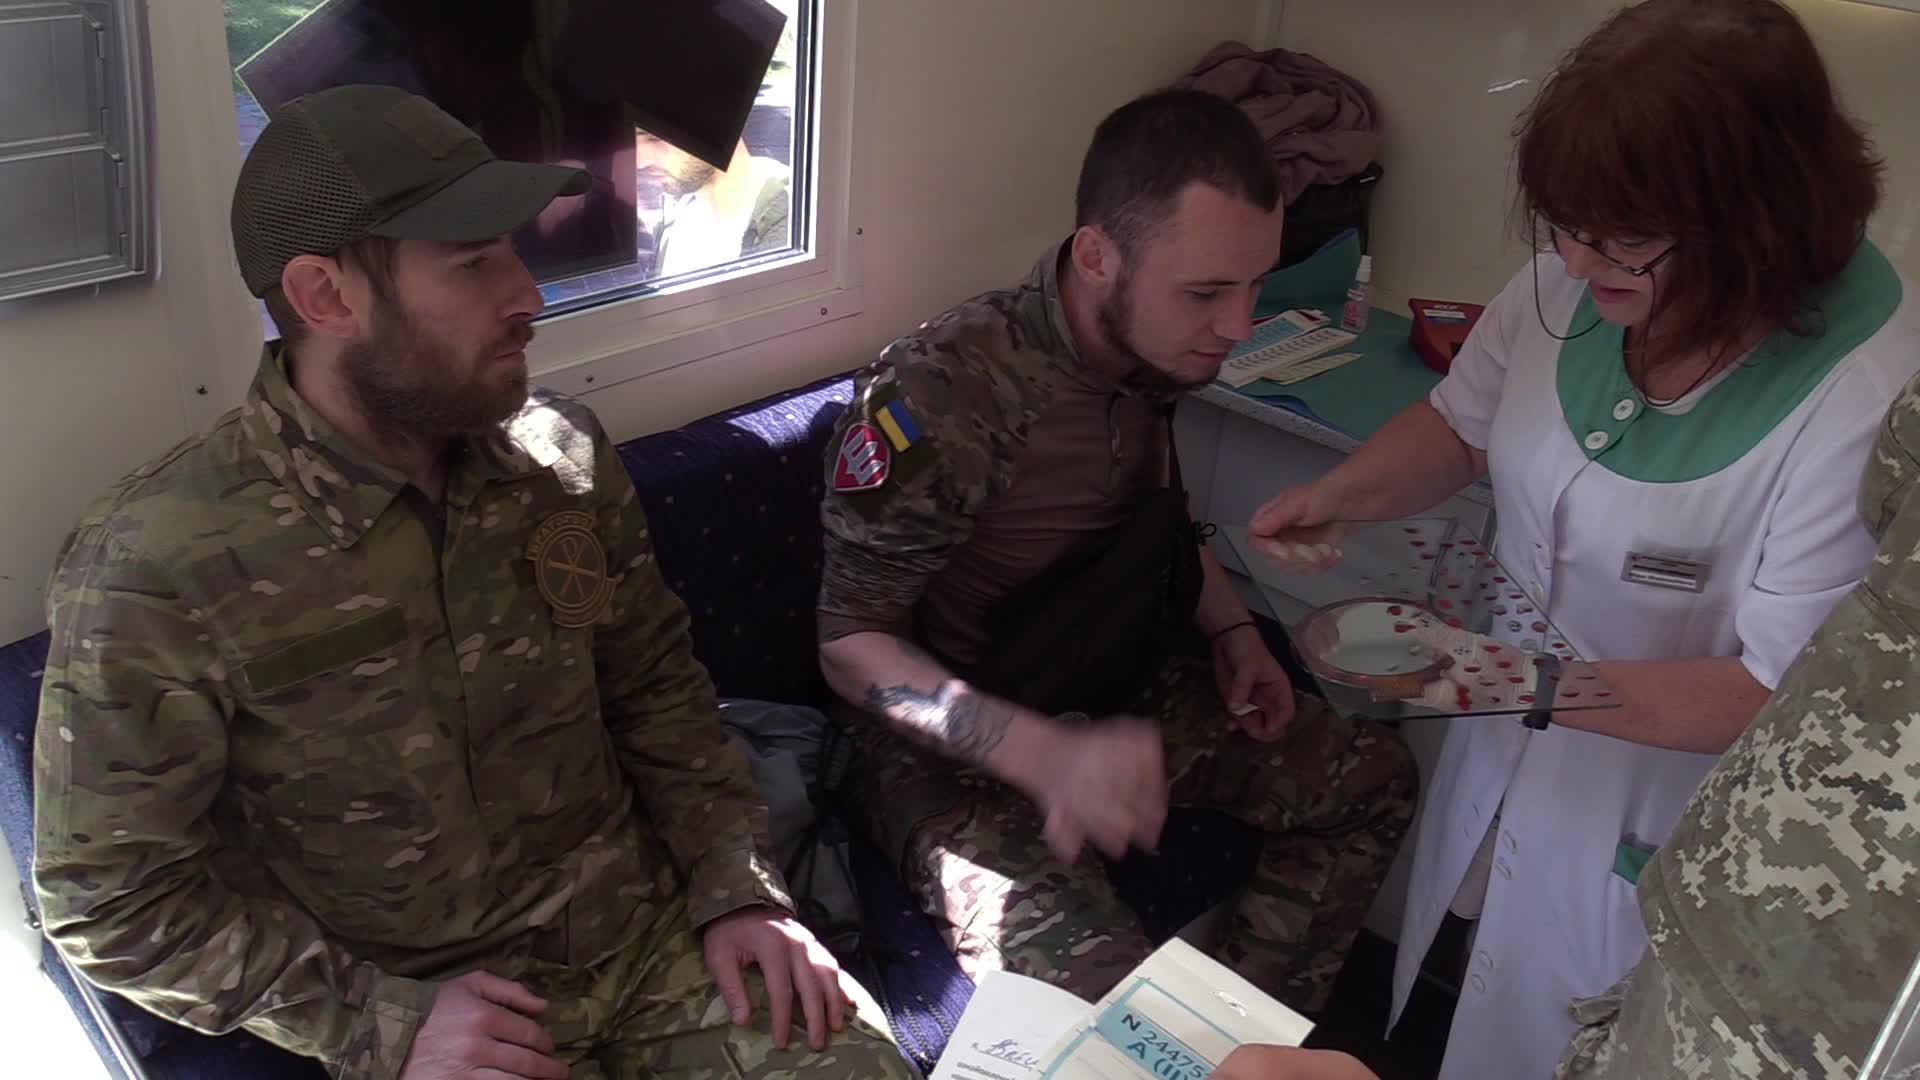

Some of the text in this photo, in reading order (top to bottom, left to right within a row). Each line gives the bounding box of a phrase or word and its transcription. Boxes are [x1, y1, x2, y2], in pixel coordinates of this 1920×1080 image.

[1121, 1013, 1209, 1079] N 24475
[1126, 1041, 1147, 1060] A
